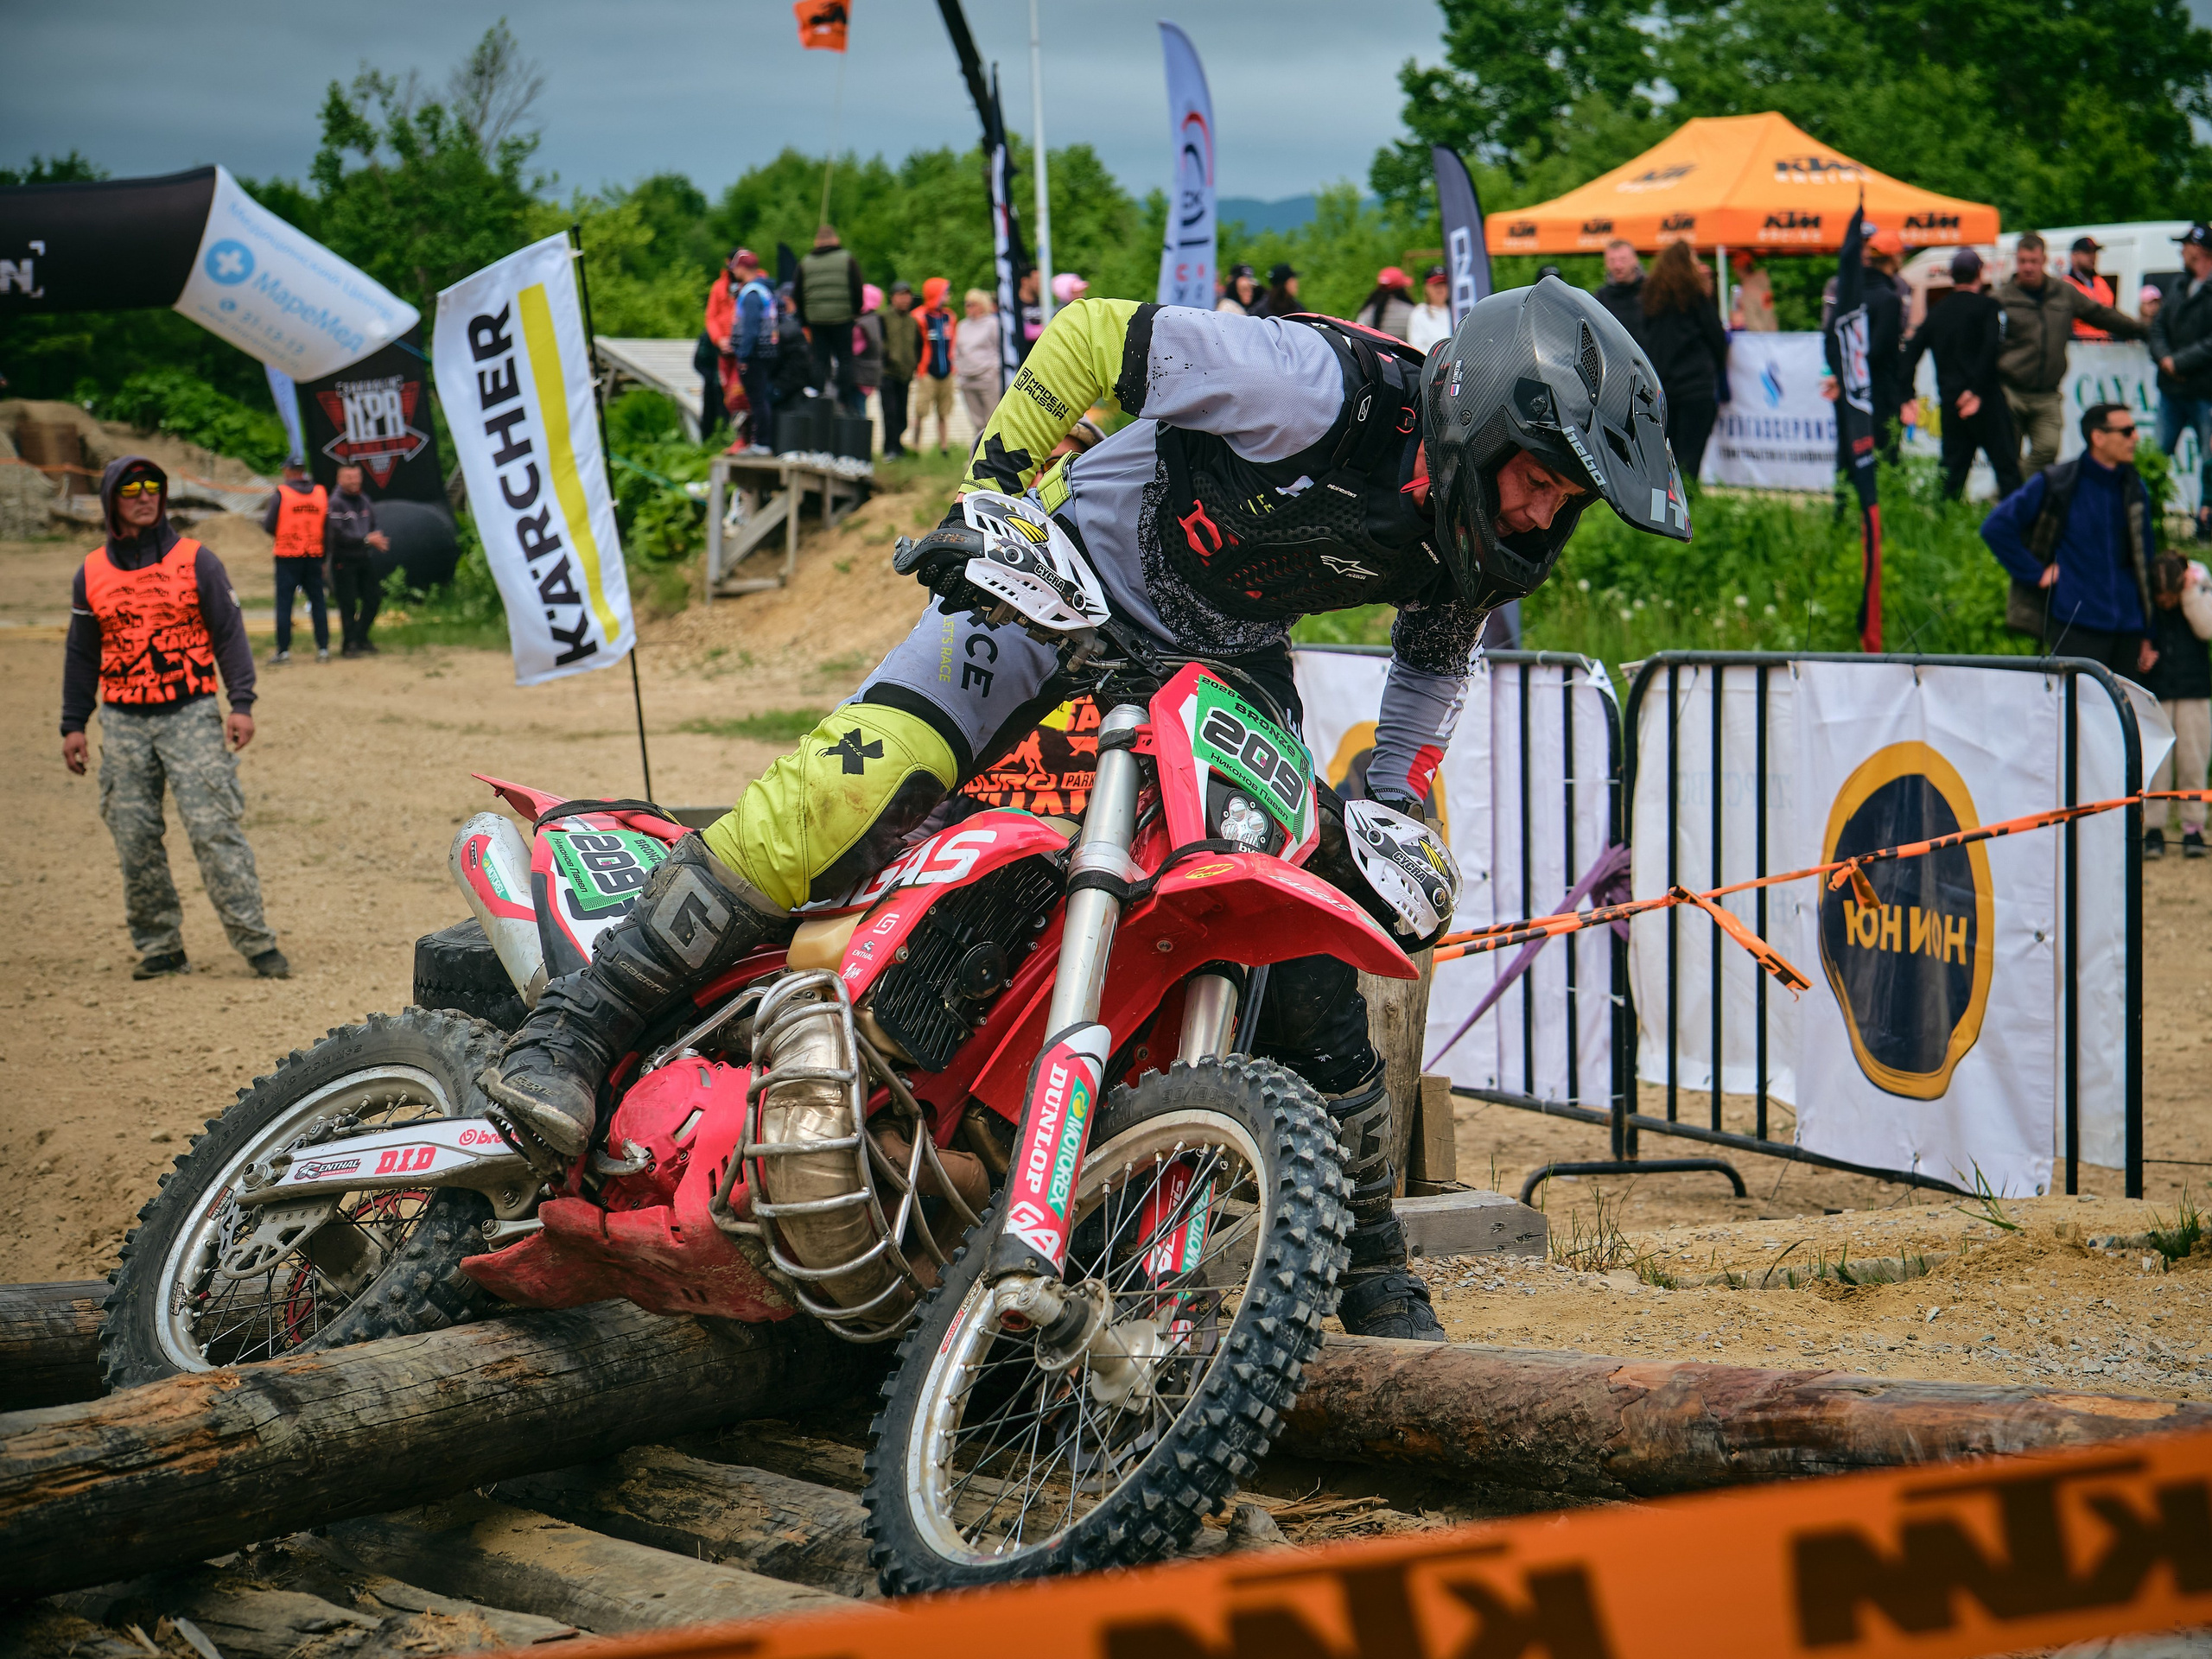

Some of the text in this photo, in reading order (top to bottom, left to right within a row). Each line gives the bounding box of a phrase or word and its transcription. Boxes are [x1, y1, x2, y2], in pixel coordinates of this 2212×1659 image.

[1764, 211, 1822, 228] KTM
[1904, 210, 1961, 228] KTM
[1024, 385, 1065, 421] RUSSIA
[1029, 378, 1070, 415] MADE IN
[1561, 425, 1607, 486] hebo
[467, 300, 598, 667] KÄRCHER
[1326, 483, 1357, 499] alpinestars
[1035, 563, 1065, 592] CYCRA
[938, 647, 954, 683] RACE
[1203, 709, 1303, 810] 209
[569, 835, 645, 894] 209
[1392, 851, 1427, 882] CYCRA
[1026, 1062, 1070, 1194] DUNLOP
[374, 1146, 437, 1175] D.I.D
[1052, 1115, 1085, 1211] MOTOREX
